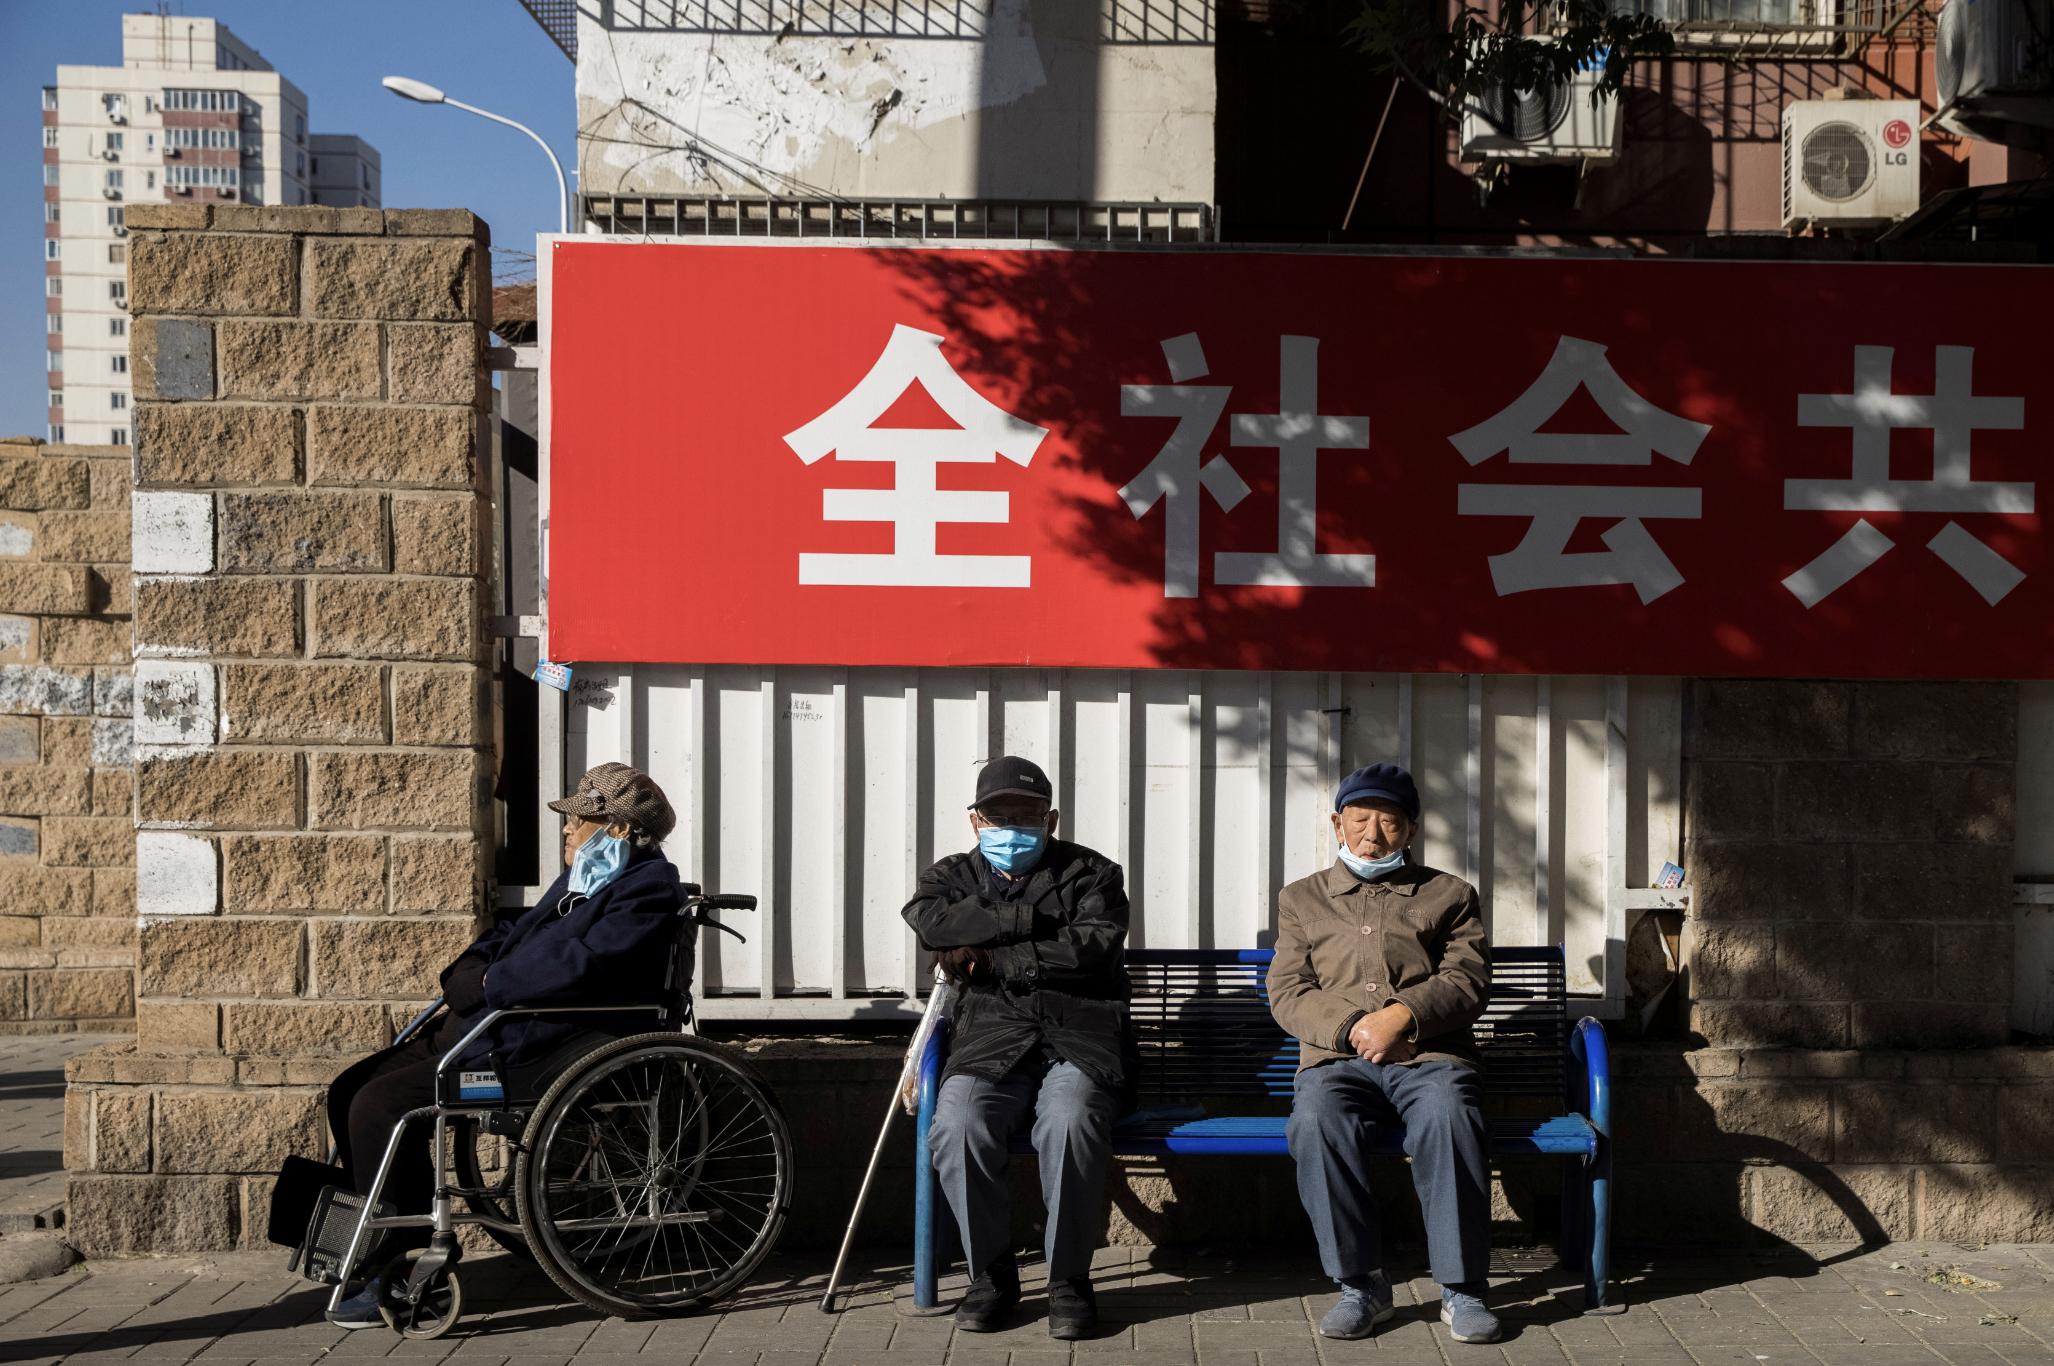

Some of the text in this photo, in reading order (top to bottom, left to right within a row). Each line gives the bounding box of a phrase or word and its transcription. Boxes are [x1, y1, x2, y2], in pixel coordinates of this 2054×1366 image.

[1885, 152, 1908, 166] LG
[782, 323, 2035, 609] 全社会共
